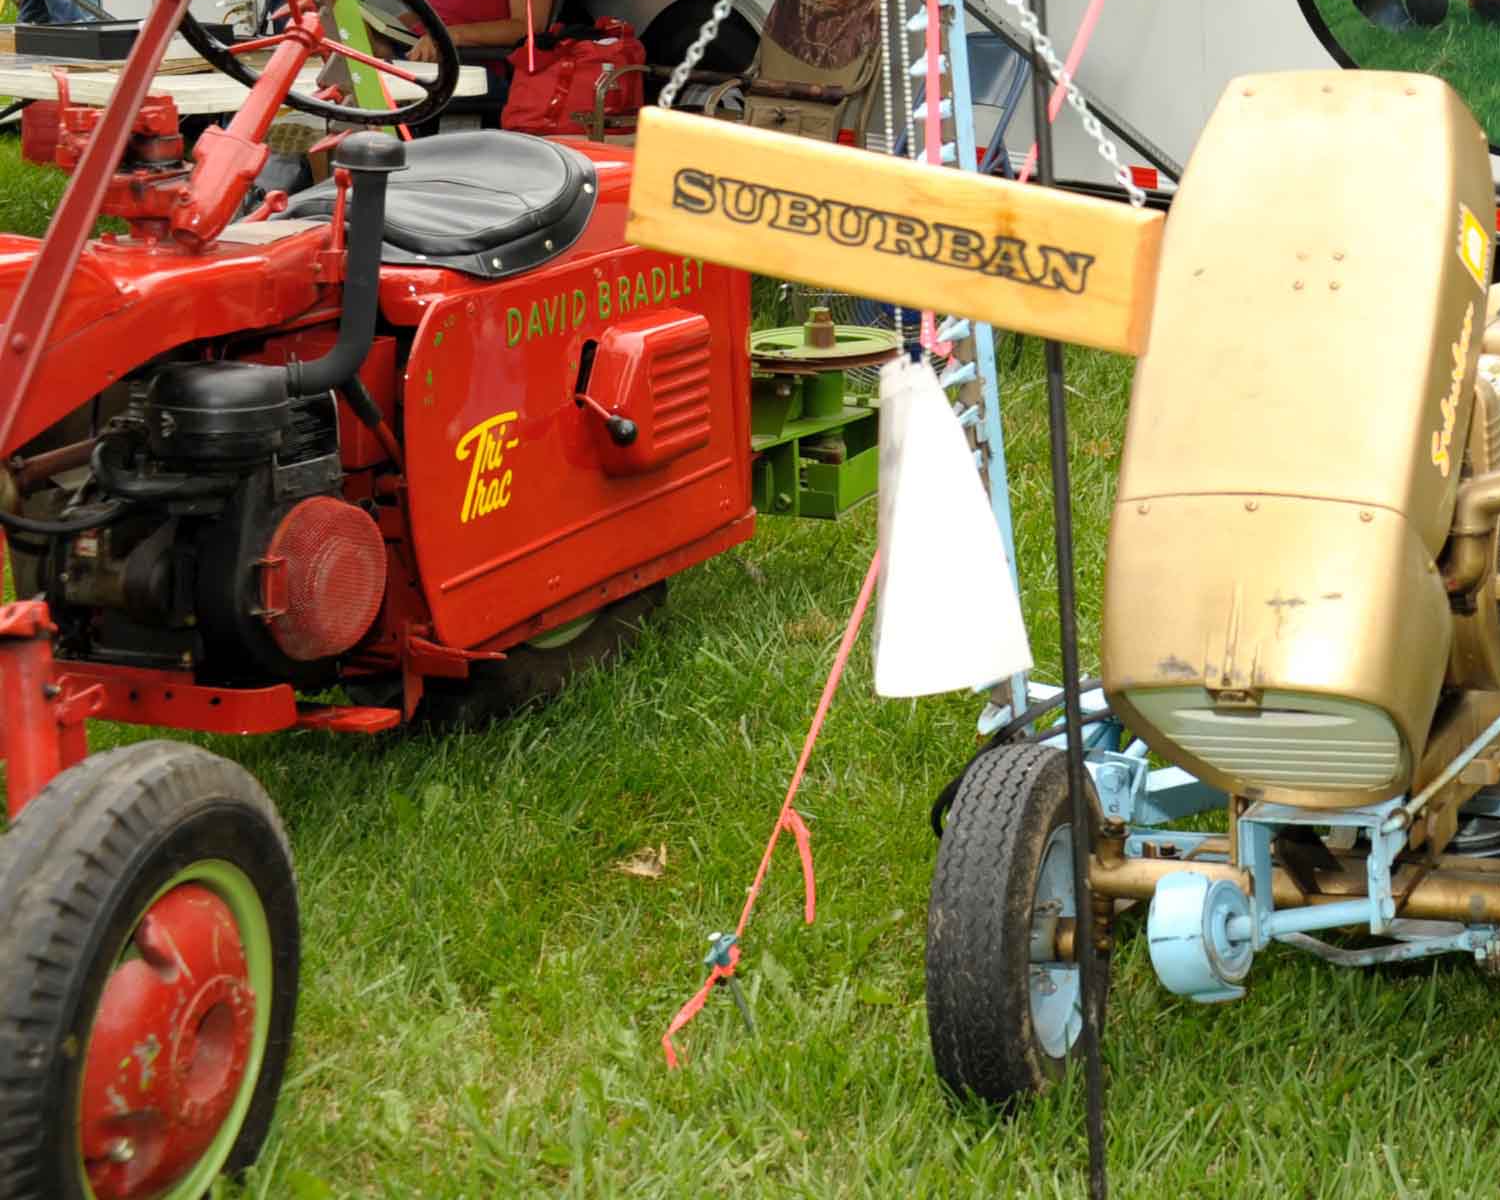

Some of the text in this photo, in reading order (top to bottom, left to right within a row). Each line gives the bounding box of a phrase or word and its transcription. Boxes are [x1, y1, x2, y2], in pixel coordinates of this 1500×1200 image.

[672, 169, 1094, 294] SUBURBAN
[506, 289, 586, 348] DAVID
[598, 256, 704, 320] BRADLEY
